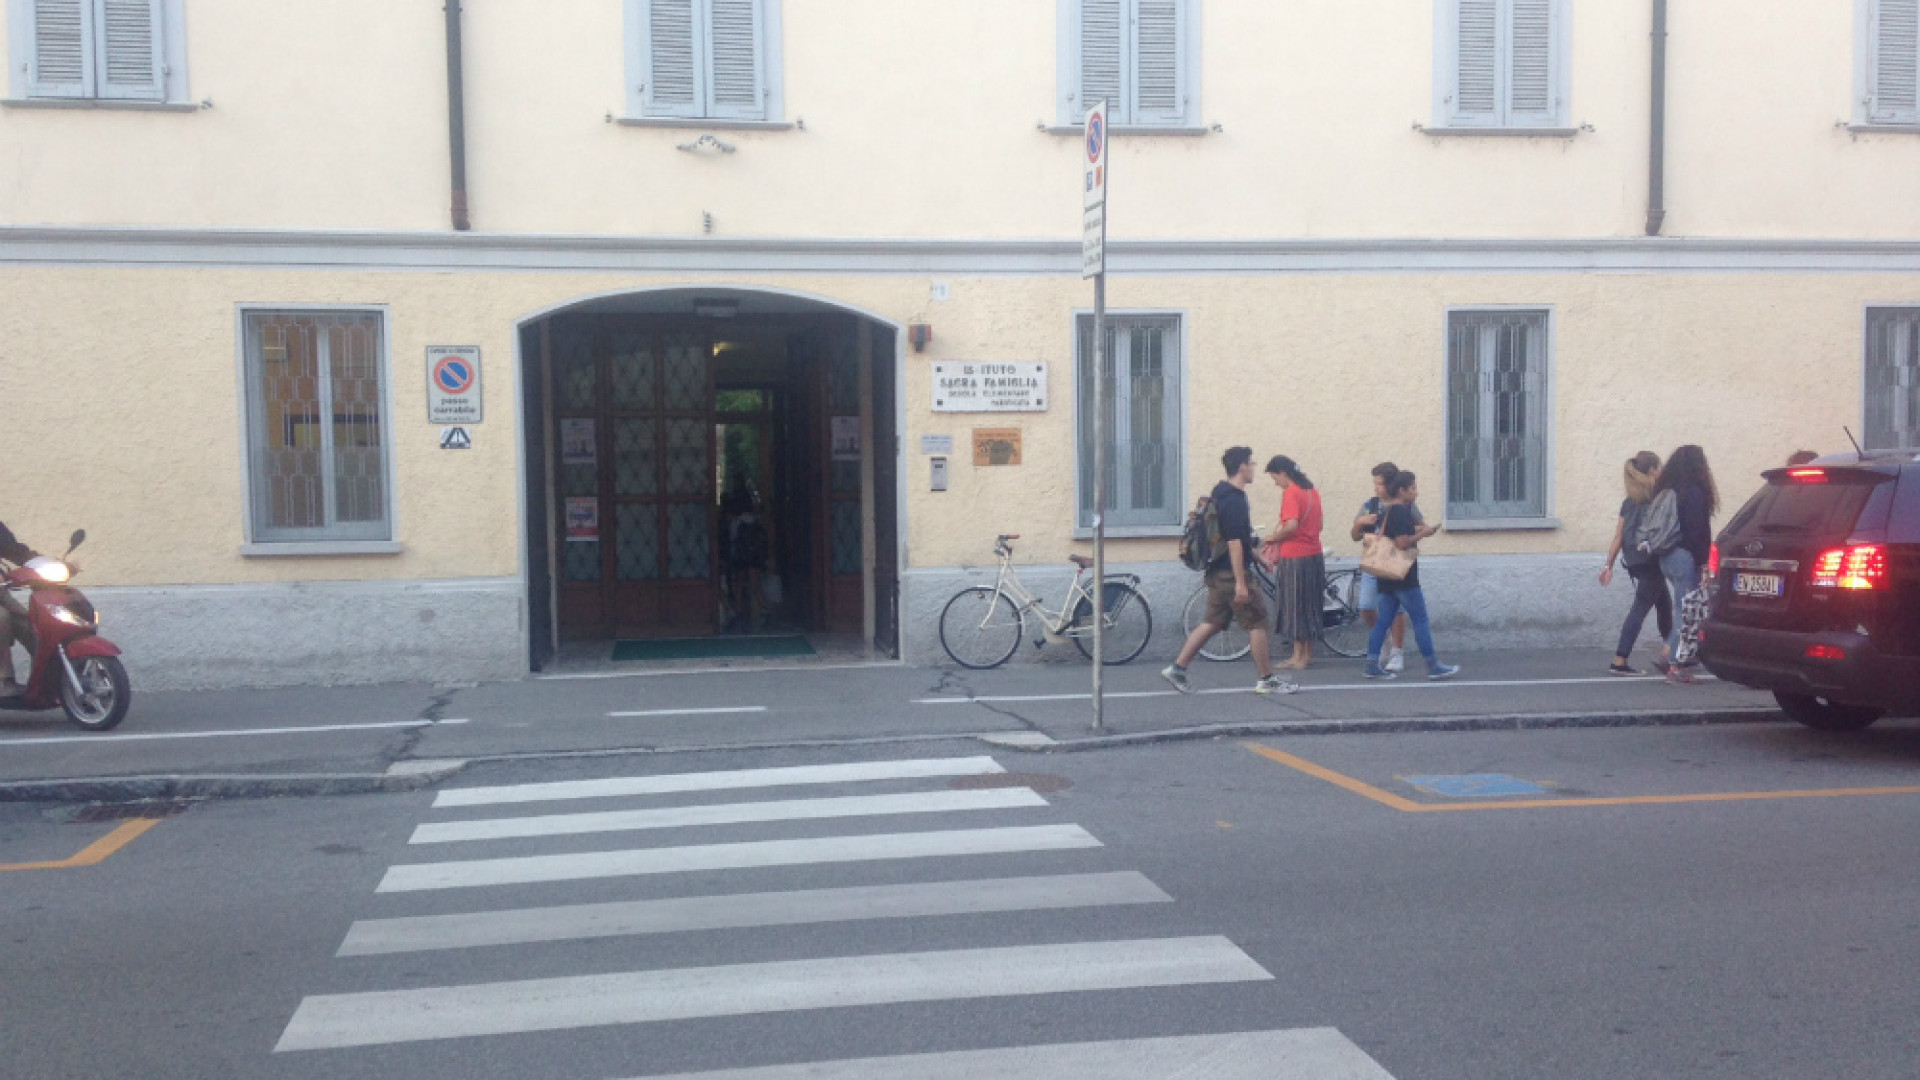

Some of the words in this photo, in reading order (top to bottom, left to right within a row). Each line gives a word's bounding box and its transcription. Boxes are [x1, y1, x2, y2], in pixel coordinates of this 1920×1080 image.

[963, 364, 1017, 374] ISITUTO
[940, 377, 978, 388] SACRA
[984, 377, 1038, 388] FAMIGLIA
